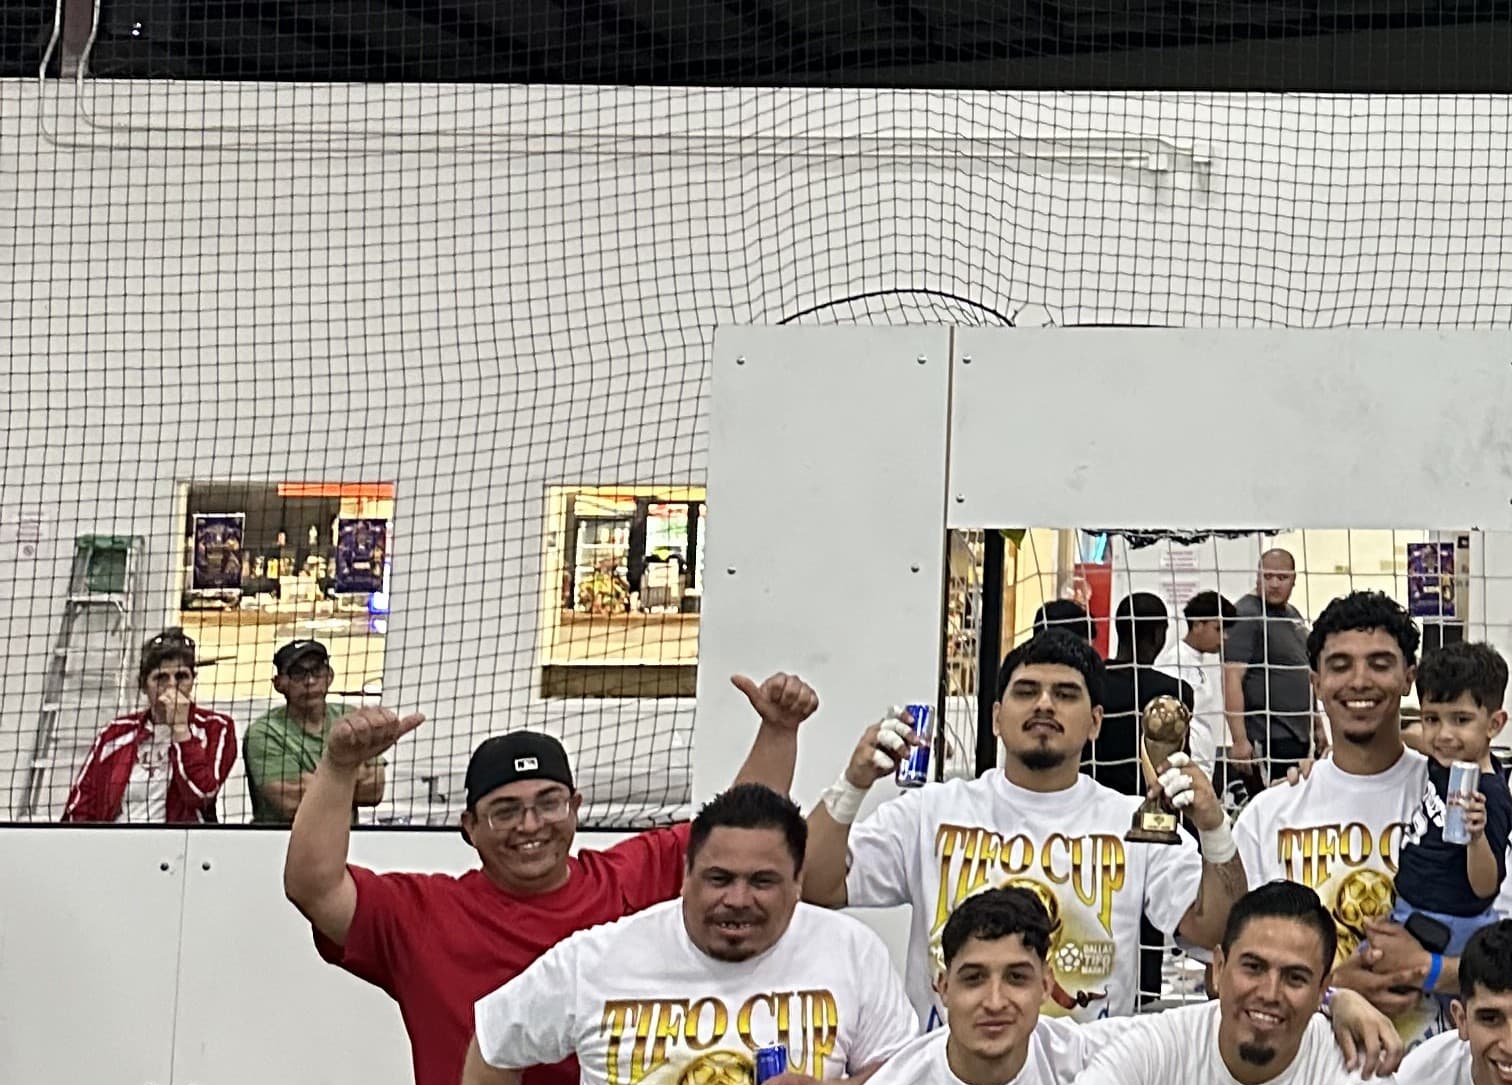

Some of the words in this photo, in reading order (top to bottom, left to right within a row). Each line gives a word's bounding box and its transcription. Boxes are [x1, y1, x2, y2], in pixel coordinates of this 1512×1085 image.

[930, 823, 1035, 937] TIFO
[1040, 832, 1126, 938] CUP
[1277, 821, 1373, 889] TIFO
[737, 989, 839, 1080] CUP
